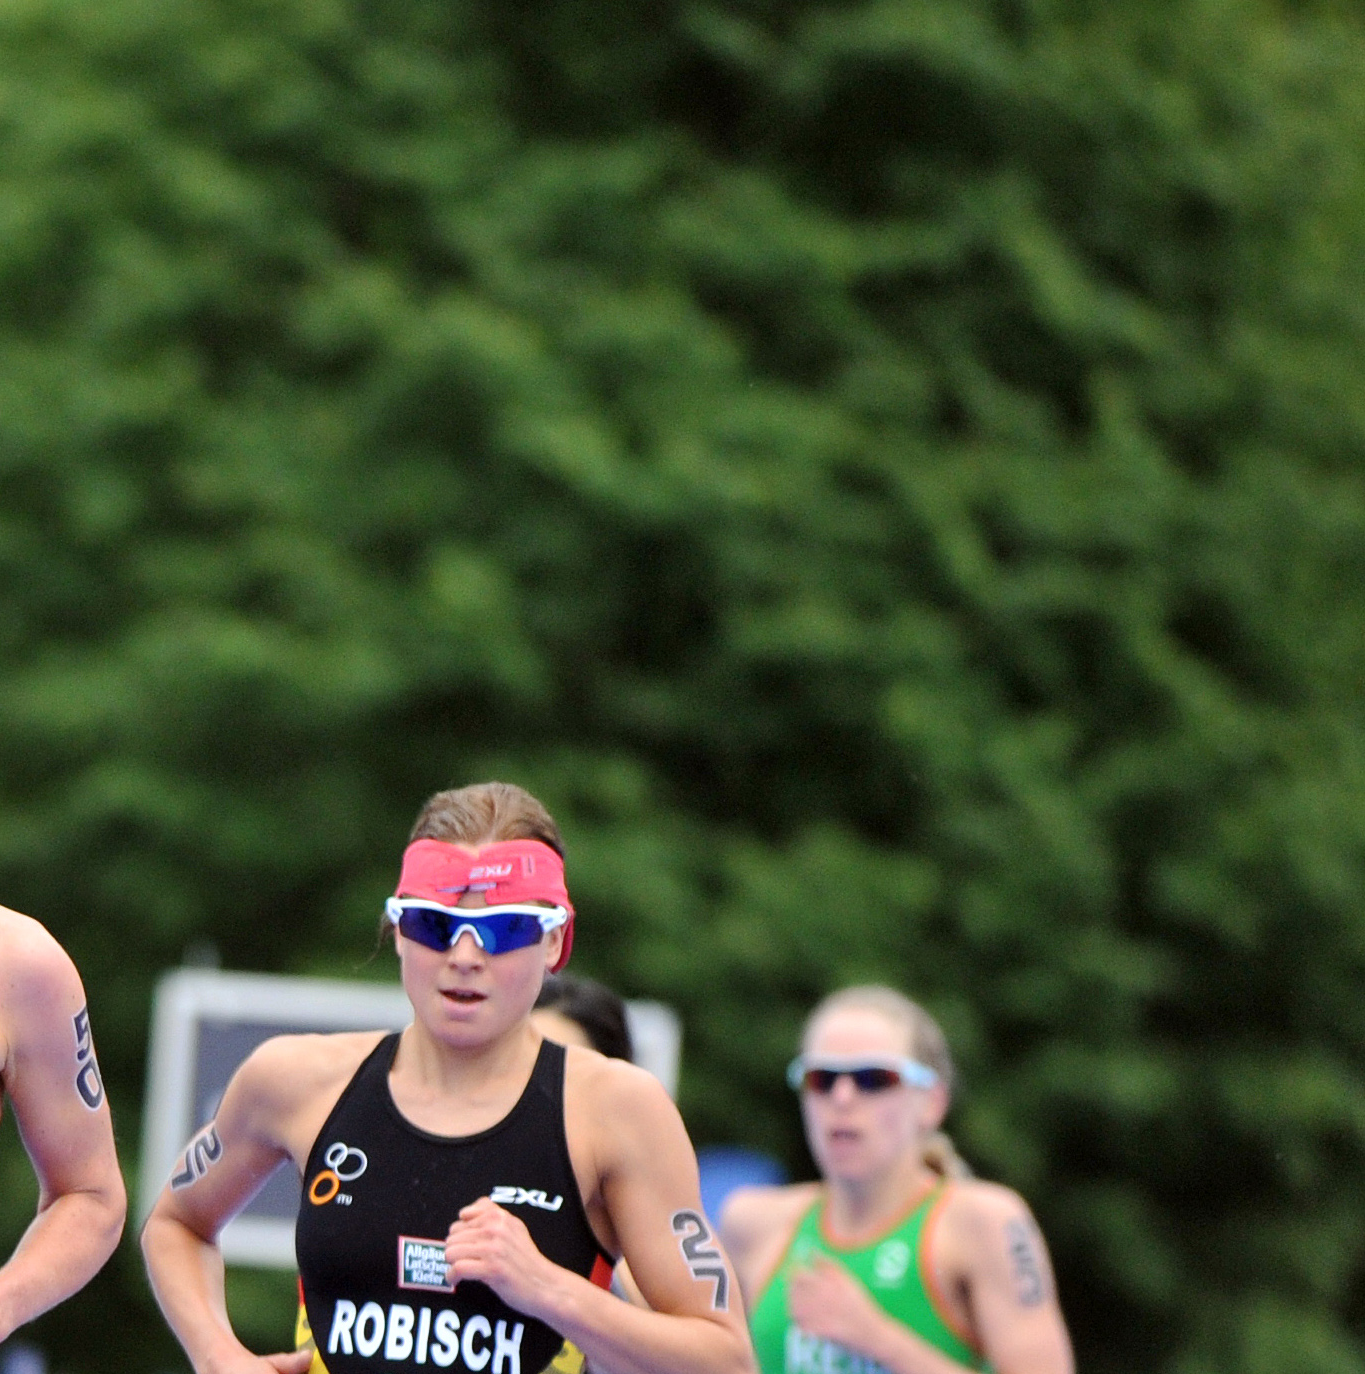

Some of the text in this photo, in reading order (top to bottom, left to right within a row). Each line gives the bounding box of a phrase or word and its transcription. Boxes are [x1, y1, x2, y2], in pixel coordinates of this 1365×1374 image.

[469, 863, 513, 879] 2XU
[490, 1185, 564, 1212] 2XU
[672, 1210, 729, 1312] 27
